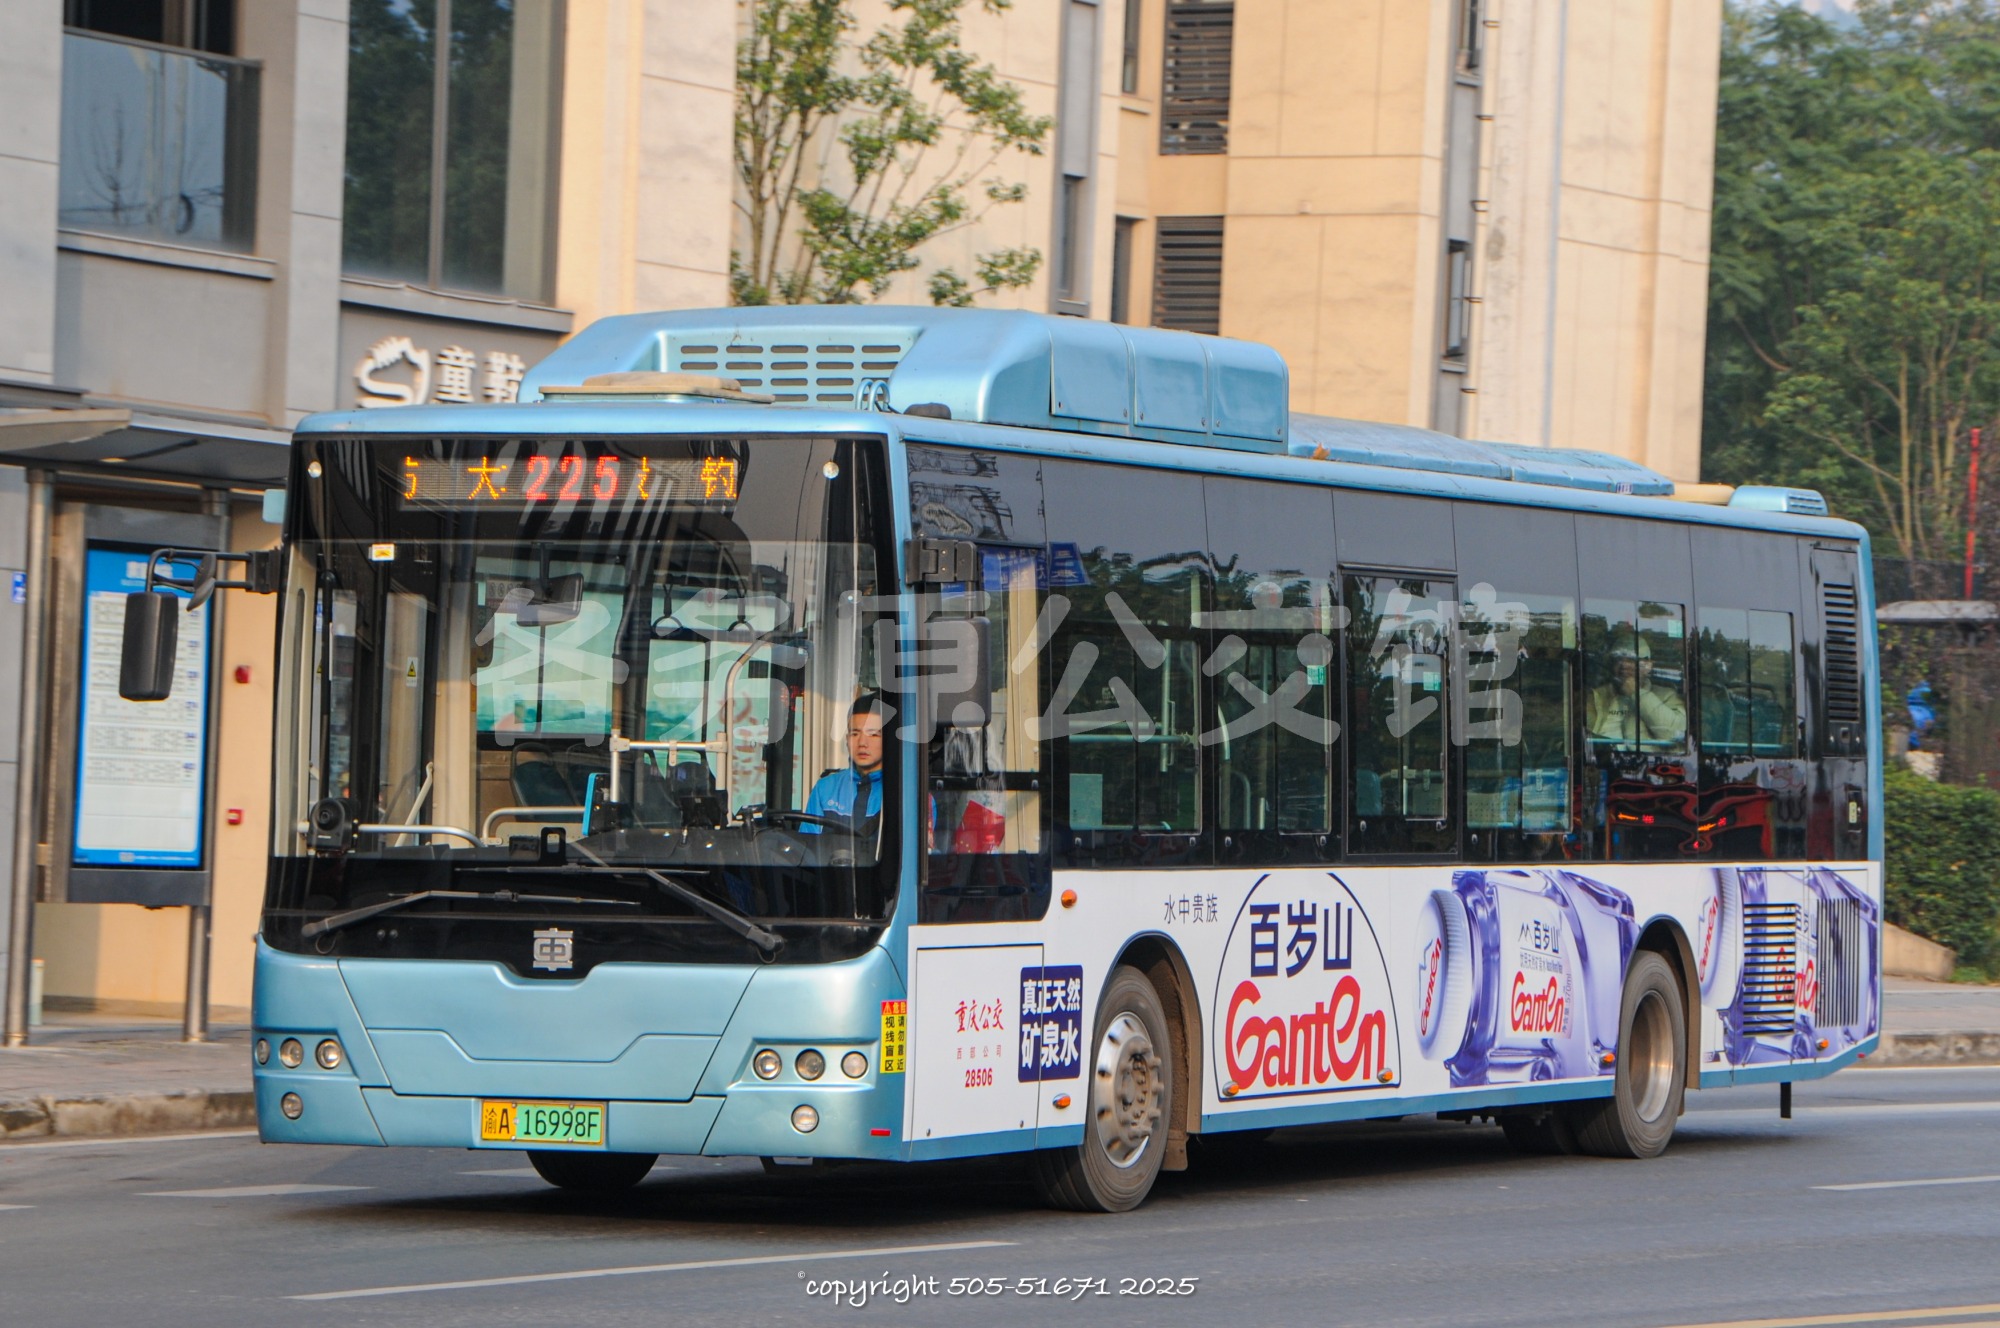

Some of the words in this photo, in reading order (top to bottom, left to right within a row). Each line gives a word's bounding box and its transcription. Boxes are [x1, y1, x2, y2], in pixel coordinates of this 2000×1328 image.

[525, 456, 619, 501] 225
[1164, 893, 1218, 925] 水中贵族
[1249, 900, 1354, 978] 百岁山
[1533, 919, 1560, 955] 百岁山
[955, 998, 1004, 1033] 重庆公交
[1022, 978, 1081, 1015] 真正天然
[1511, 970, 1564, 1033] Ganten
[885, 1016, 895, 1071] 视线盲区
[1021, 1019, 1079, 1069] 矿泉水
[1225, 976, 1386, 1089] Ganten
[965, 1068, 993, 1088] 28506
[484, 1107, 510, 1135] 渝A
[523, 1109, 600, 1138] 16998F
